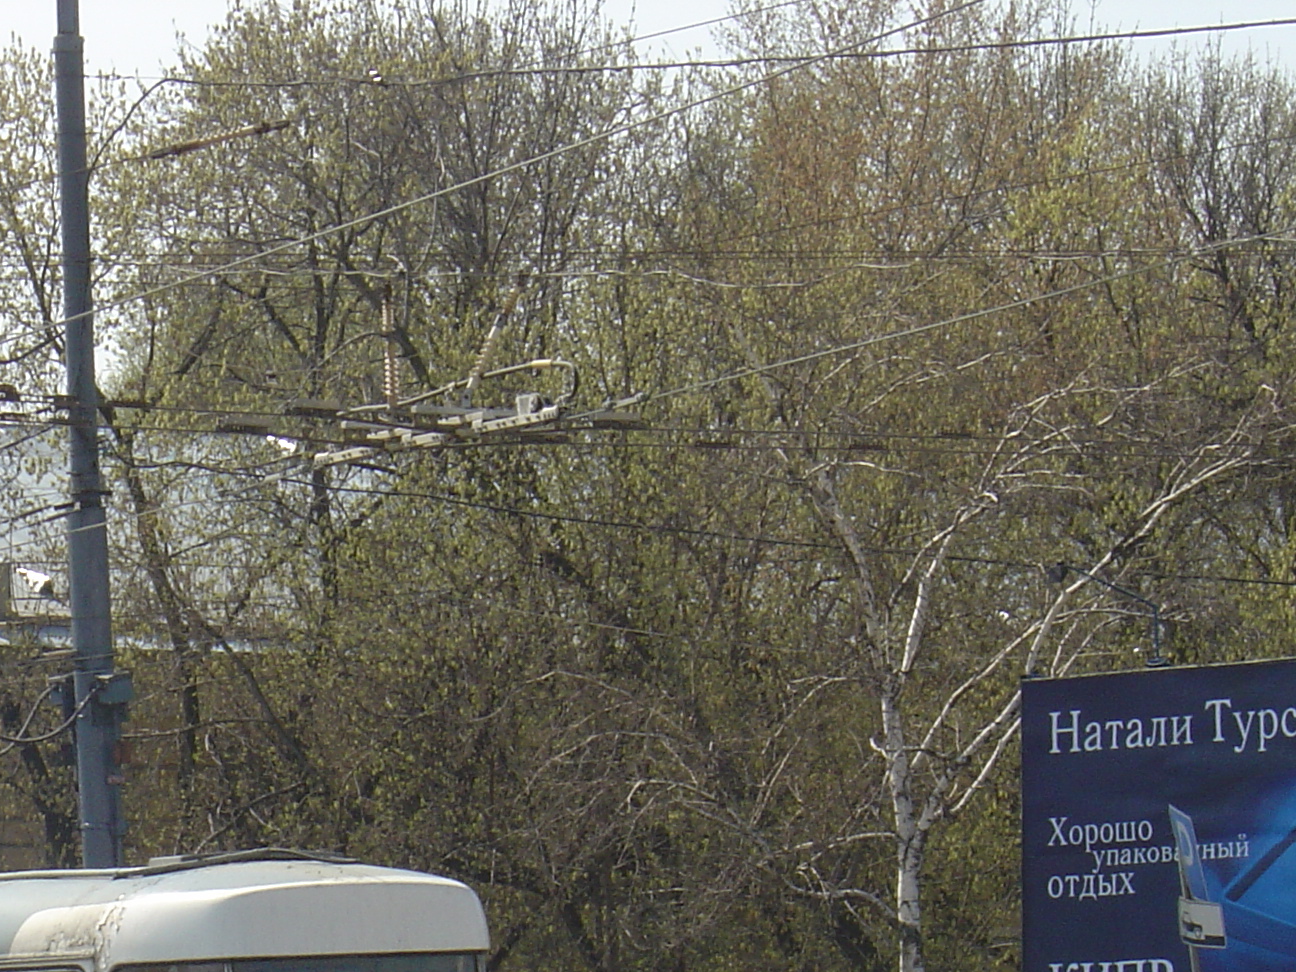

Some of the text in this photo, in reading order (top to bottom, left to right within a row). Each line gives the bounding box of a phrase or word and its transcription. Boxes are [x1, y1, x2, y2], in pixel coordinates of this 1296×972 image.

[1048, 710, 1194, 754] Натали
[1047, 816, 1153, 852] Хорошо
[1092, 833, 1250, 873] упакованый
[1047, 872, 1136, 901] отдых
